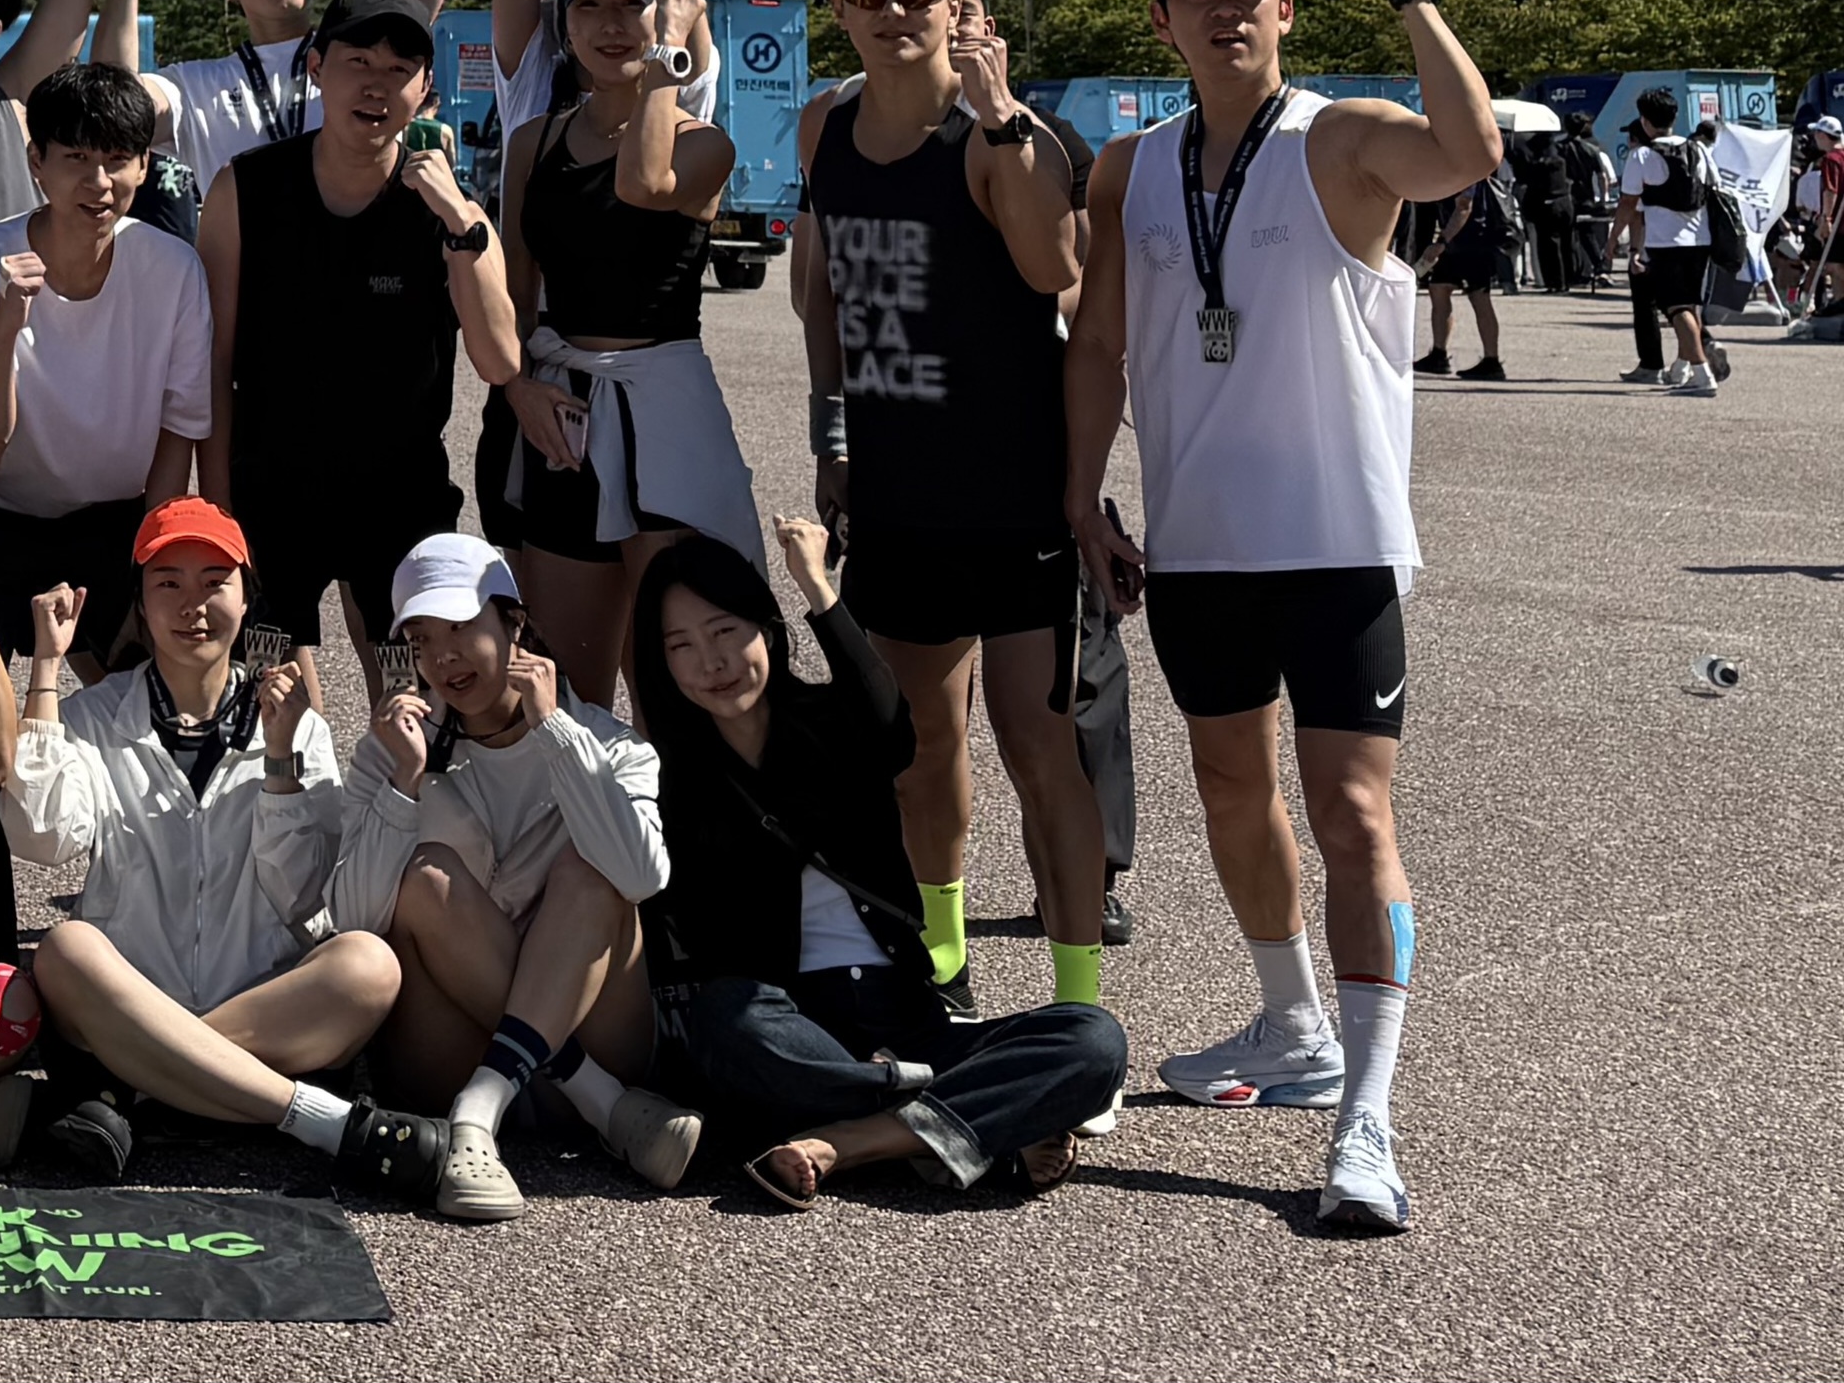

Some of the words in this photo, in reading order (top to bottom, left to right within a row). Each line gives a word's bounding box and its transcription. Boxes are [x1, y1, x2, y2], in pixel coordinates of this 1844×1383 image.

[825, 214, 930, 263] YOUR
[874, 308, 910, 351] A
[1196, 310, 1237, 332] WWF
[842, 351, 949, 399] LACE
[246, 629, 292, 657] WWF
[375, 645, 421, 670] WWF
